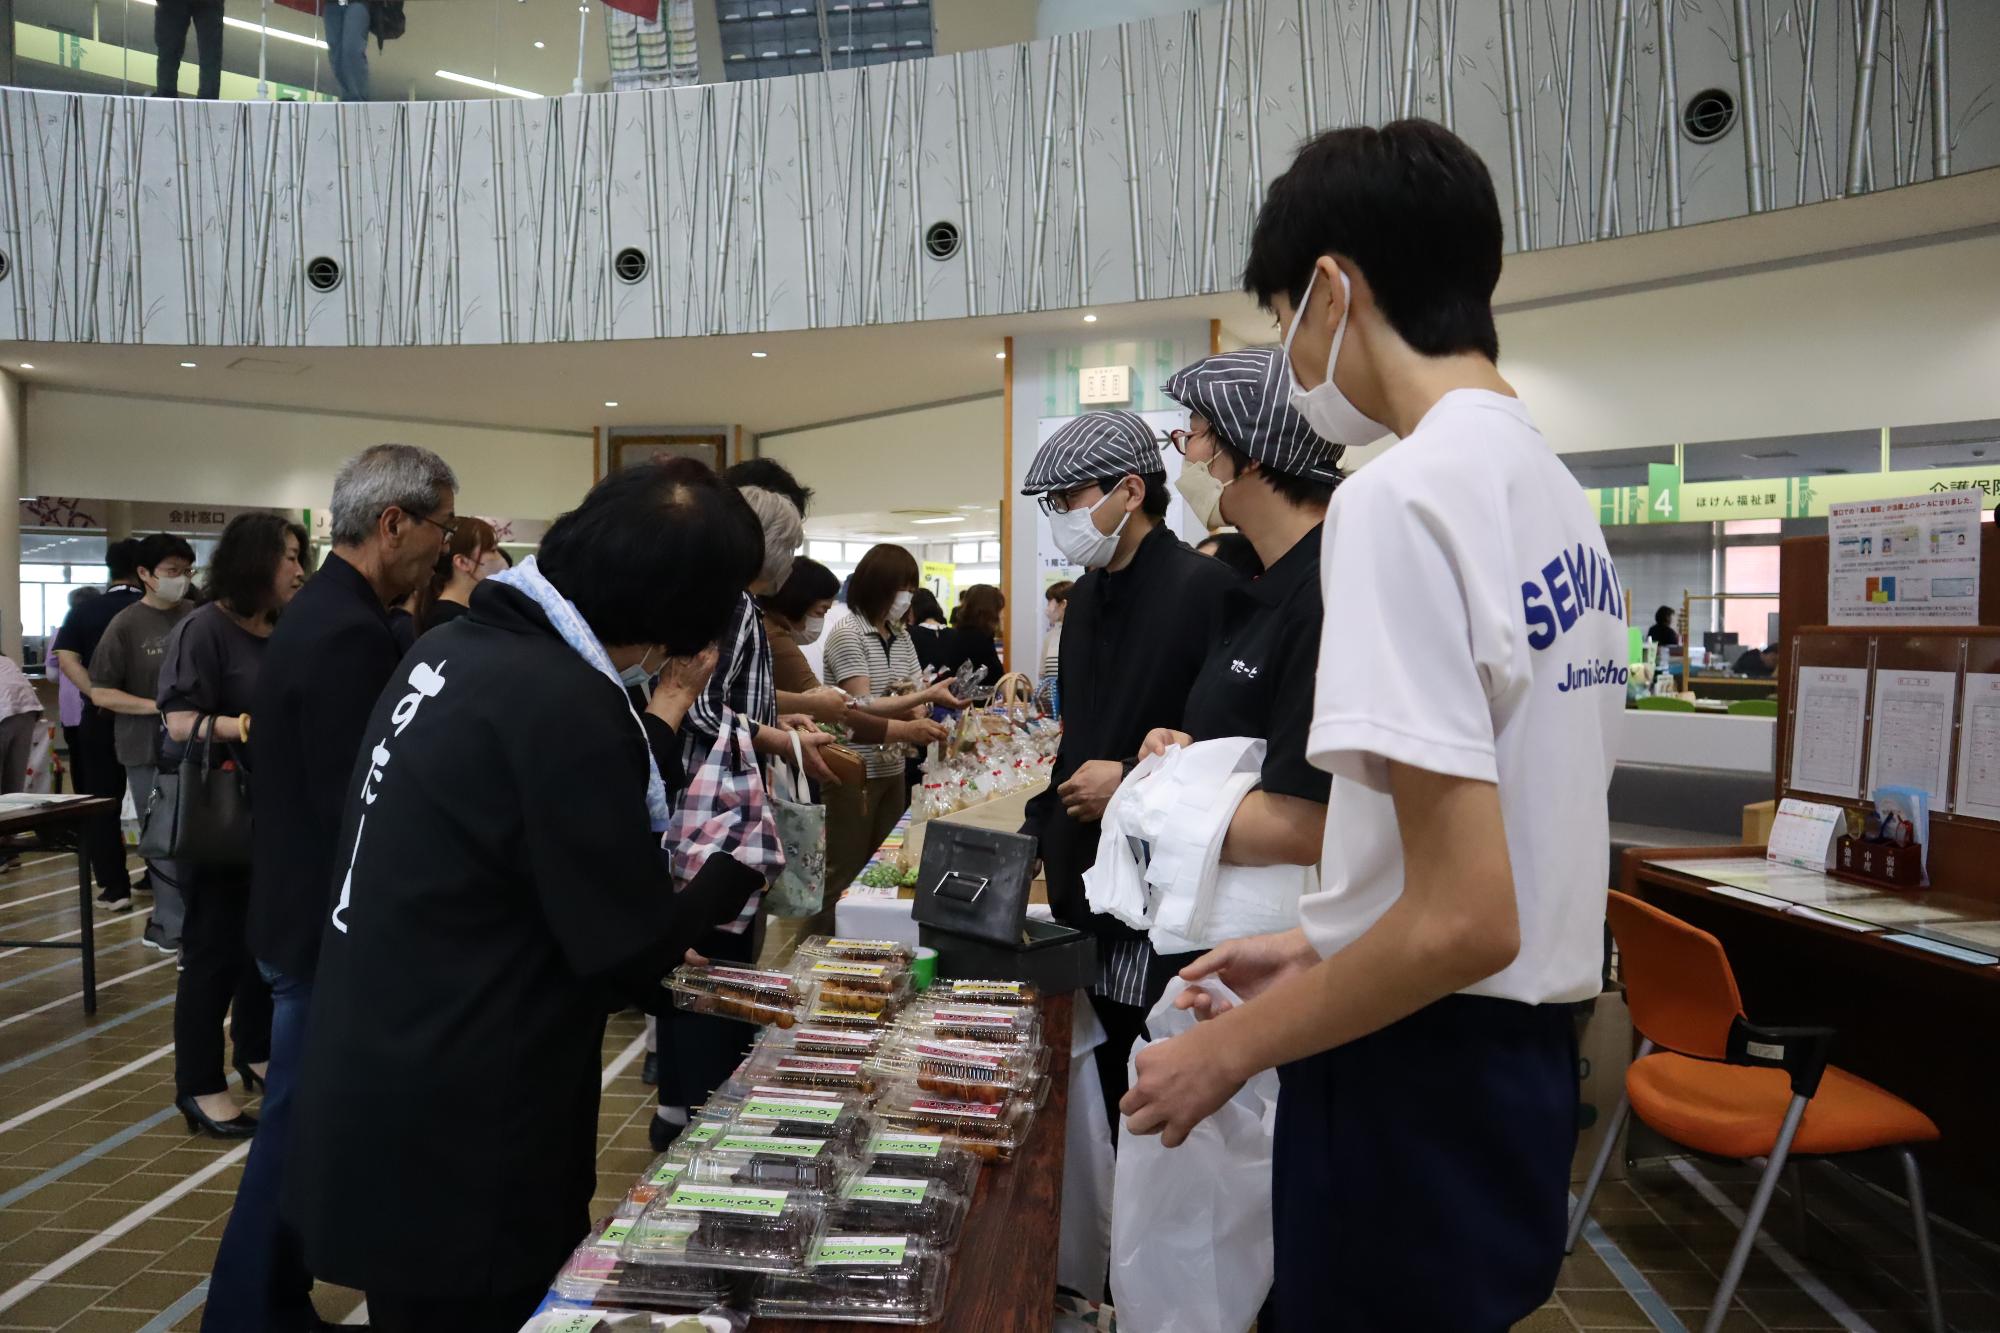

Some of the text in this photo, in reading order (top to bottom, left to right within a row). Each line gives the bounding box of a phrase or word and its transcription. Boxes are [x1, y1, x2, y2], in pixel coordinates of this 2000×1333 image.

[1654, 488, 1673, 518] 4
[1696, 493, 1777, 508] ほけん福祉課
[169, 509, 225, 525] 会計窓口
